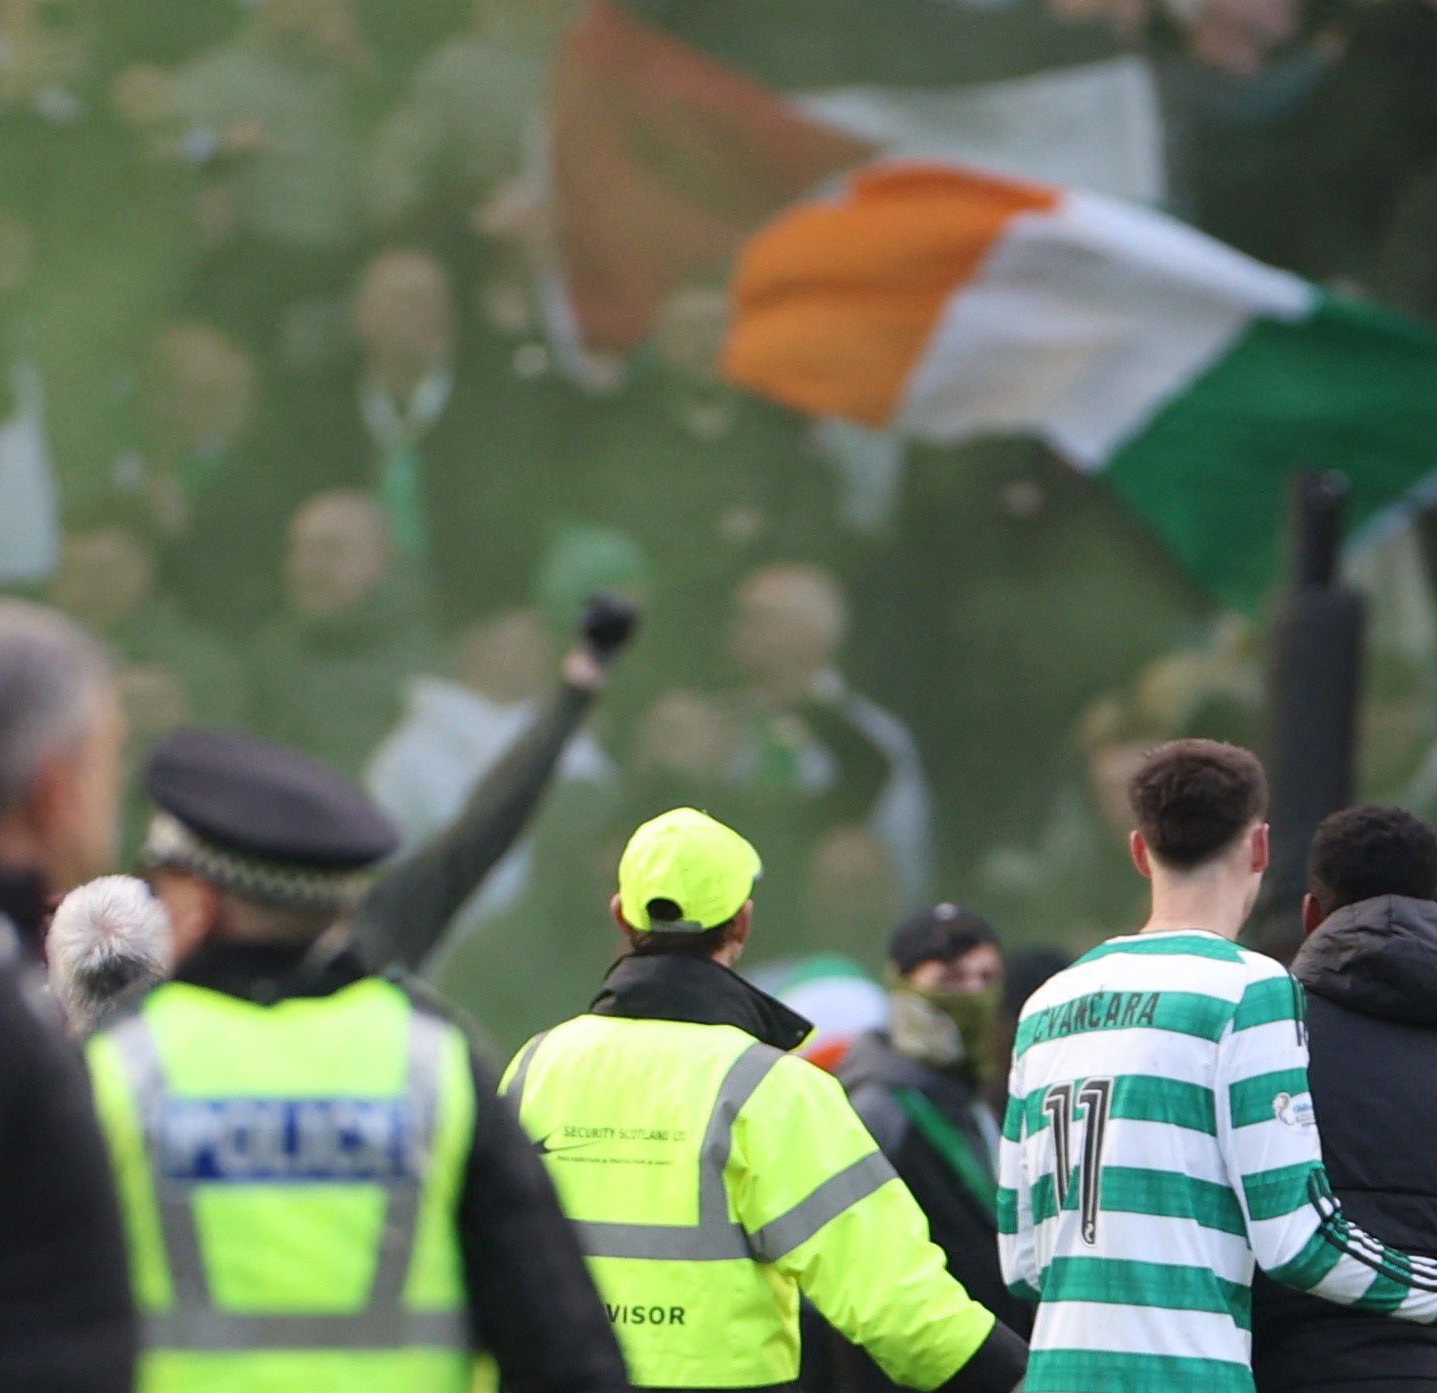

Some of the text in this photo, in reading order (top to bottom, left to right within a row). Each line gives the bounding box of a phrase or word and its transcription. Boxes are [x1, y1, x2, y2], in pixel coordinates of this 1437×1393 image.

[166, 1103, 398, 1174] POLICE
[564, 1125, 615, 1139] SECURITY
[1043, 1077, 1114, 1248] 11
